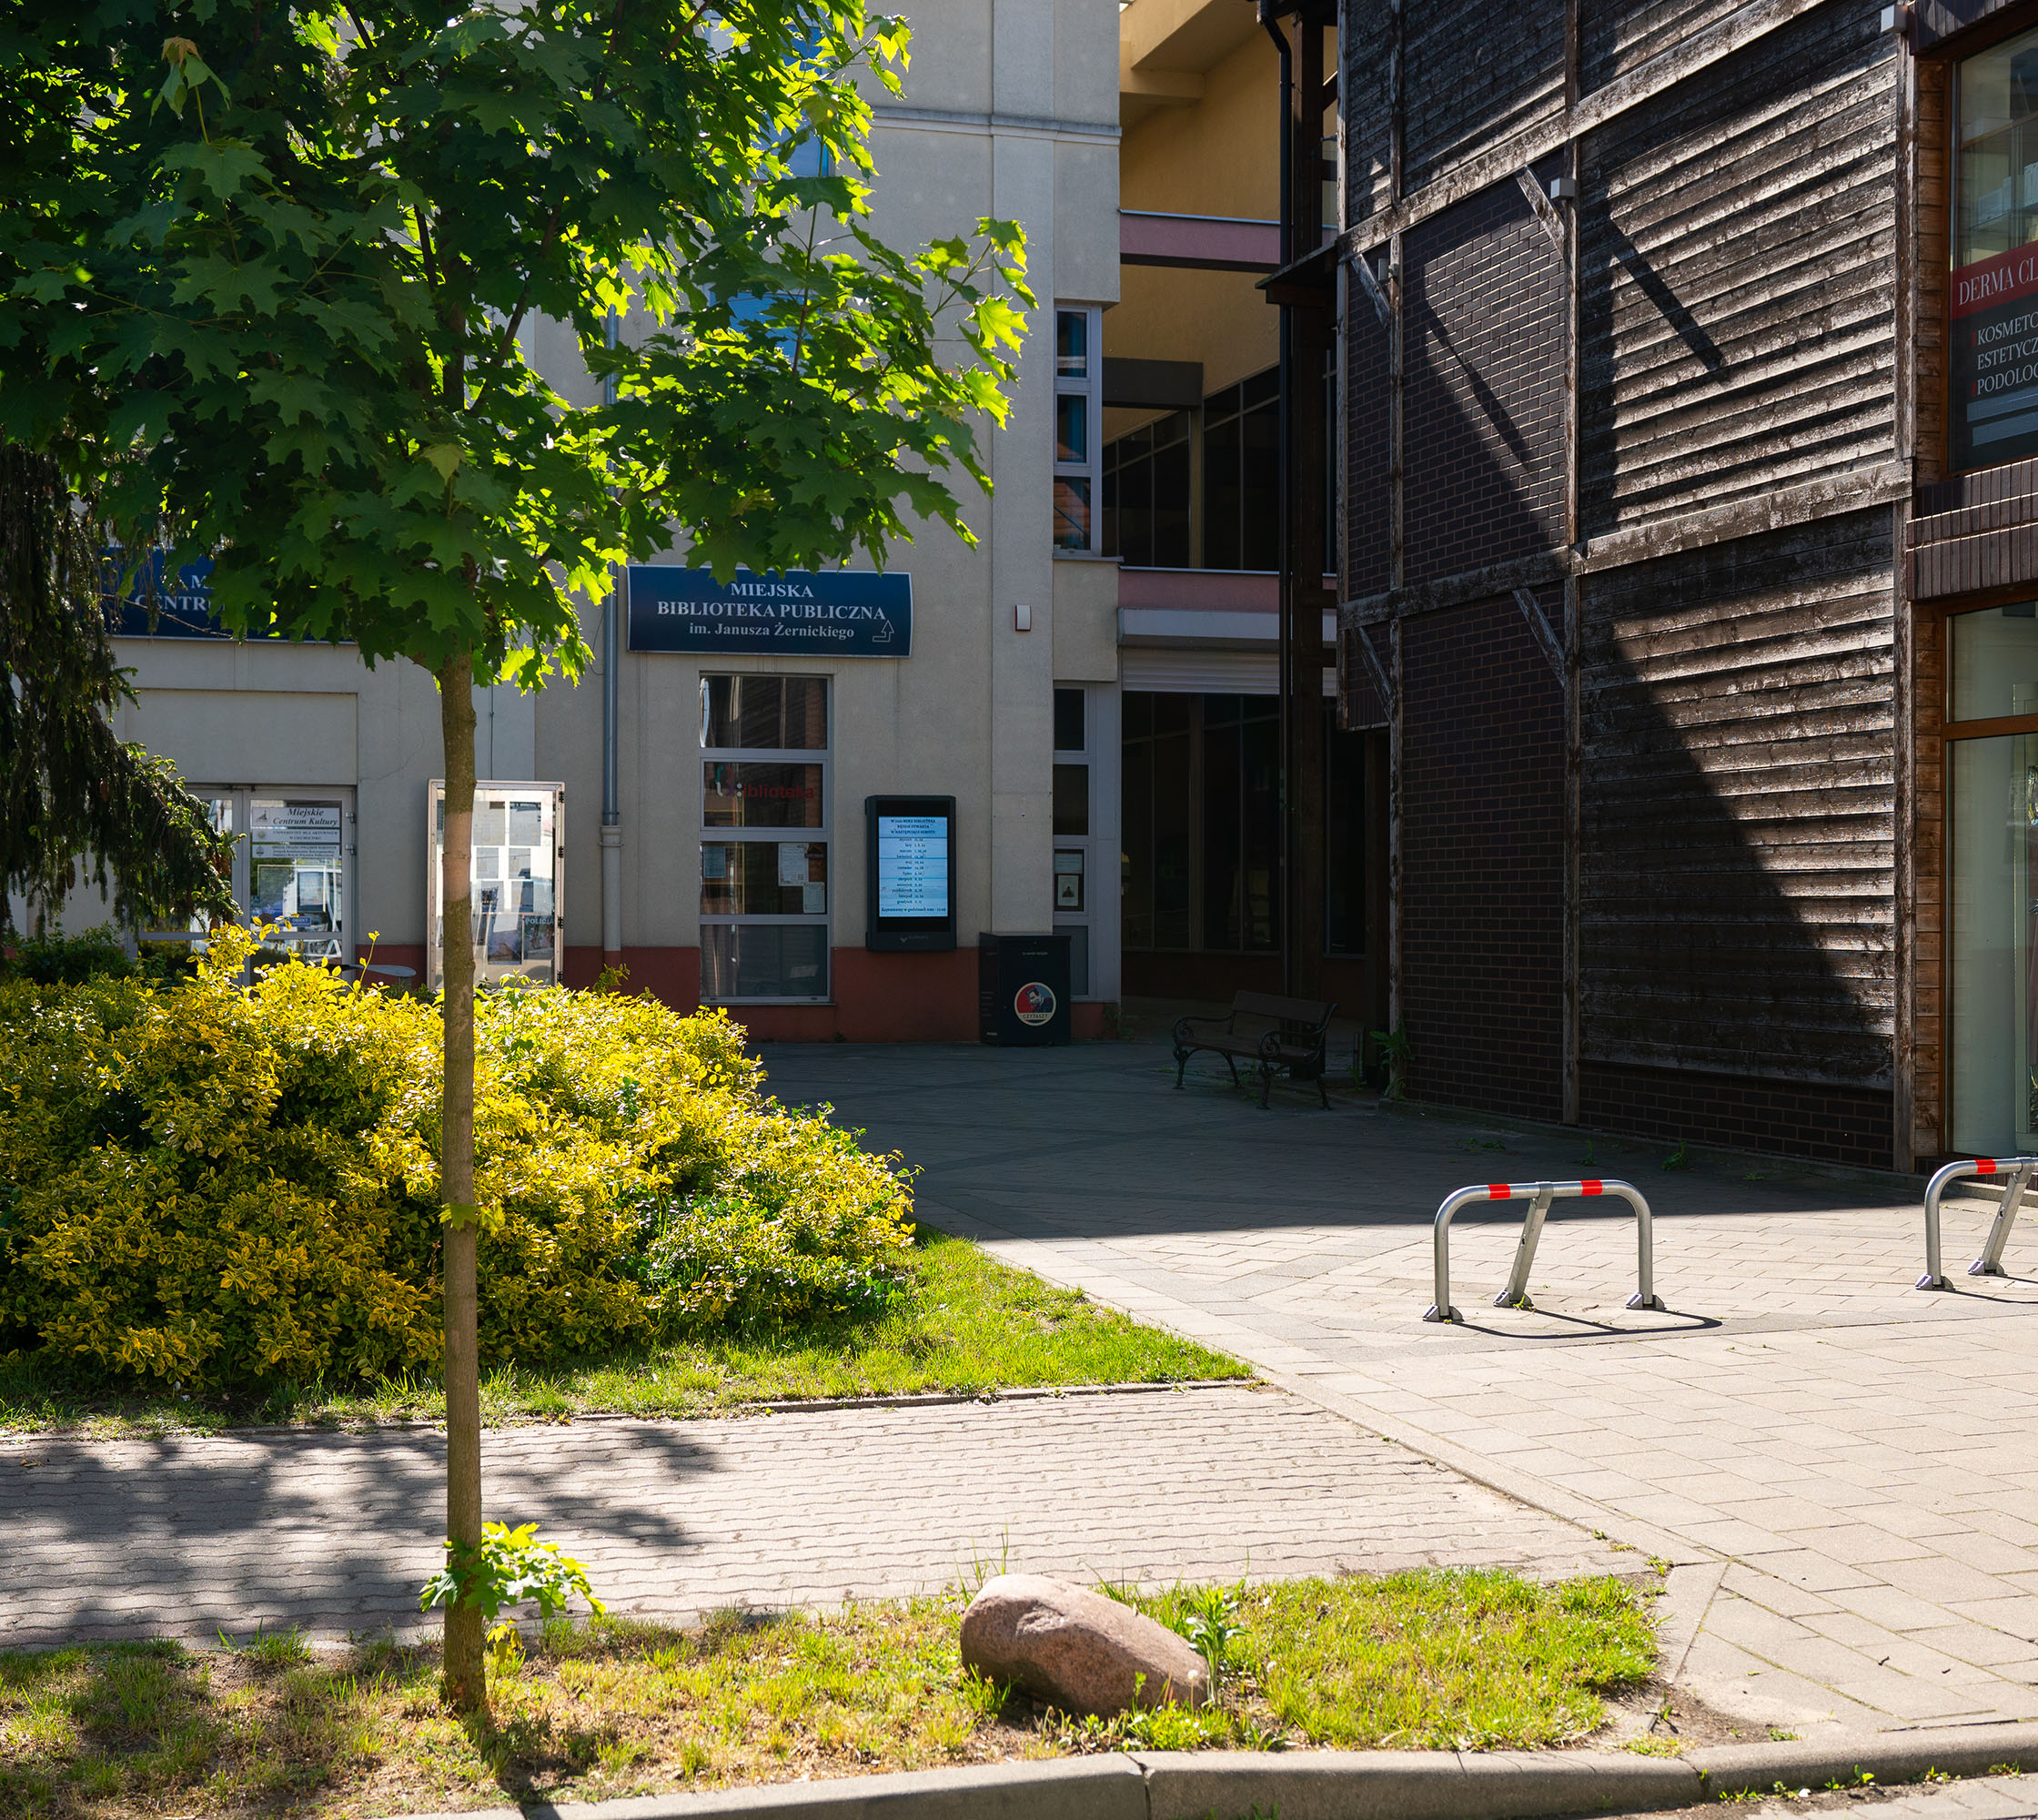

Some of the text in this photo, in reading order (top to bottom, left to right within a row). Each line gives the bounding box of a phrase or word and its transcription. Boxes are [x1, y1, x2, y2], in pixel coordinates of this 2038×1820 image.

[1959, 265, 2014, 306] DERMA
[731, 582, 814, 598] MIEJSKA
[657, 601, 887, 621] BIBLIOTEKA PUBLICZNA
[689, 622, 855, 641] im. Janusza Żernickiego
[288, 807, 324, 817] Miejskie
[273, 817, 338, 827] Centrum Kultury
